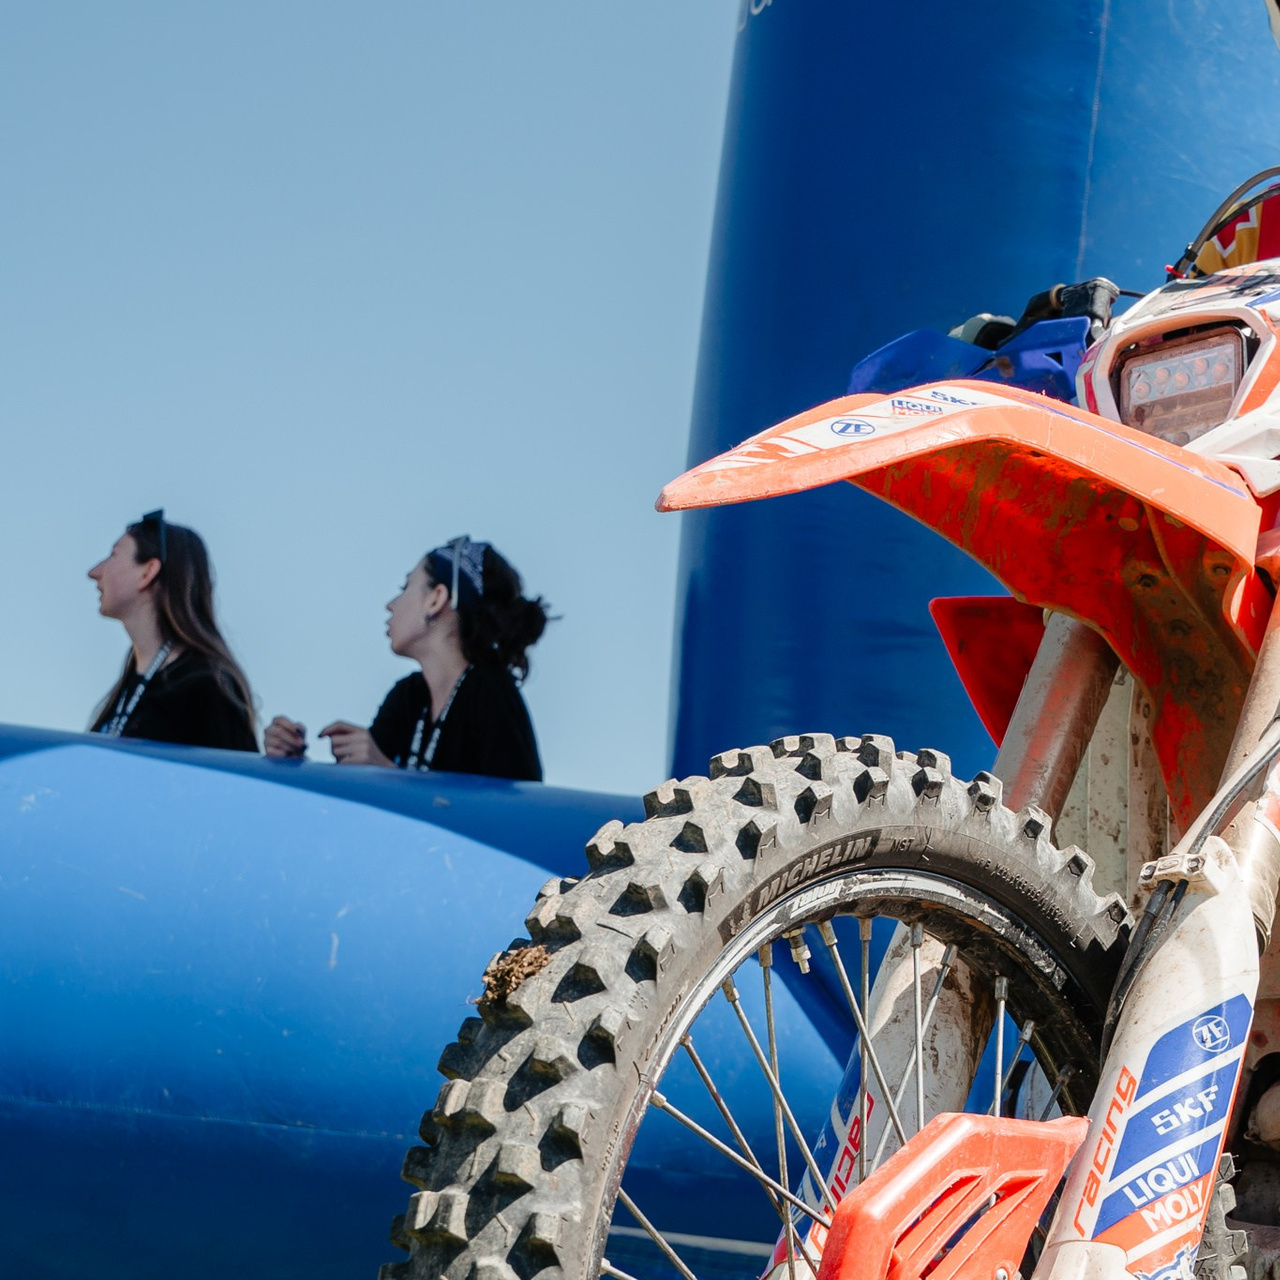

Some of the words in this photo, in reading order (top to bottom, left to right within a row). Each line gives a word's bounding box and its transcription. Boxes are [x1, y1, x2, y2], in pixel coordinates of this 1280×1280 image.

[835, 421, 872, 435] ZF
[891, 399, 944, 413] LIQUI
[756, 836, 872, 912] MICHELIN
[1197, 1018, 1226, 1050] ZF
[1151, 1085, 1219, 1136] SKF
[1074, 1064, 1137, 1238] racing
[1122, 1152, 1200, 1208] LIQUI
[1140, 1180, 1204, 1234] MOLY
